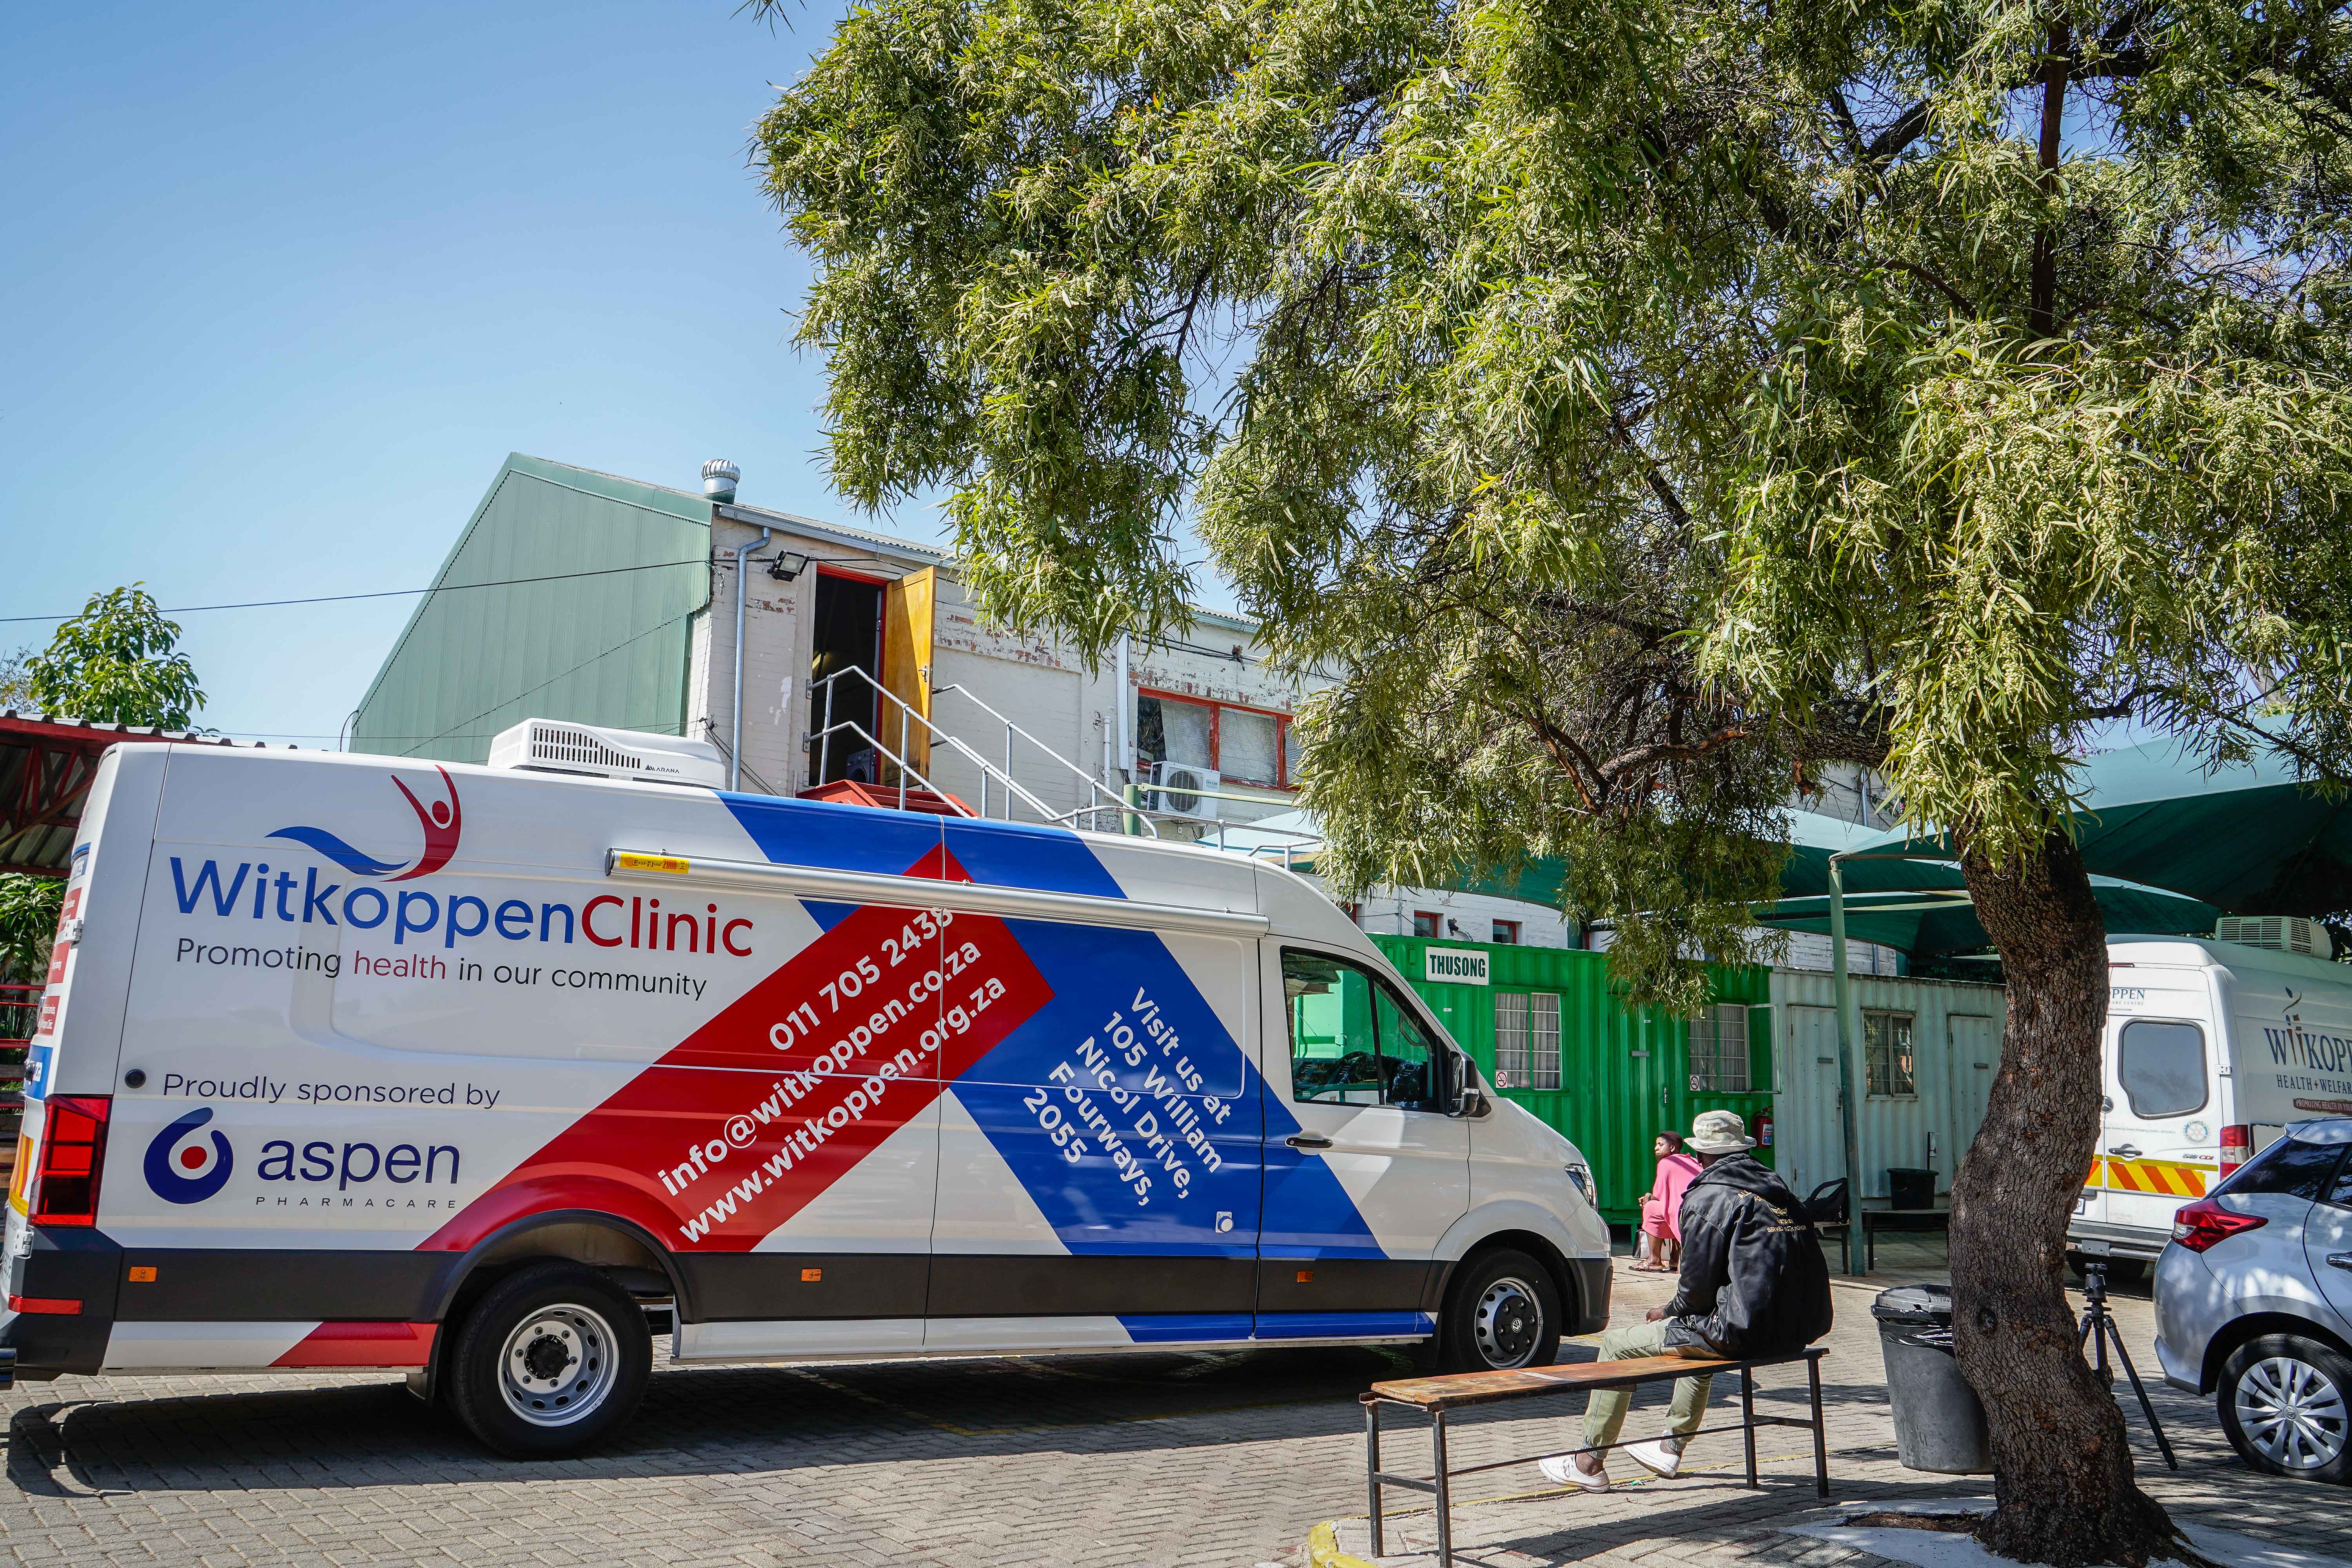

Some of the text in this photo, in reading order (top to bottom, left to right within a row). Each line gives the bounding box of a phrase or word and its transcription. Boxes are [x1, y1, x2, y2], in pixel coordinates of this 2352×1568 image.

[662, 859, 677, 870] 2000
[170, 857, 754, 957] WitkoppenClinic
[177, 937, 707, 1001] Promoting health in our community
[769, 907, 954, 1051] 011 705 2438
[1430, 955, 1485, 977] THUSONG
[2112, 989, 2145, 1000] PPEN
[657, 940, 982, 1197] info@witkoppen.co.za
[1131, 986, 1231, 1125] Visit us at
[2276, 1074, 2313, 1091] HEALTH
[2319, 1079, 2352, 1094] WELFAR
[164, 1073, 500, 1110] Proudly sponsored by
[679, 976, 1006, 1243] www.witkoppen.org.za
[1076, 1036, 1191, 1200] Nicol Drive,
[1103, 1011, 1222, 1173] 105 William
[2296, 1099, 2321, 1109] PROMOTING
[2321, 1101, 2337, 1110] HEALTH
[1022, 1088, 1088, 1163] 2055
[1048, 1060, 1153, 1207] Fourways,
[258, 1140, 460, 1191] aspen
[1737, 1190, 1752, 1199] ALL
[256, 1196, 456, 1208] PHARMACARE
